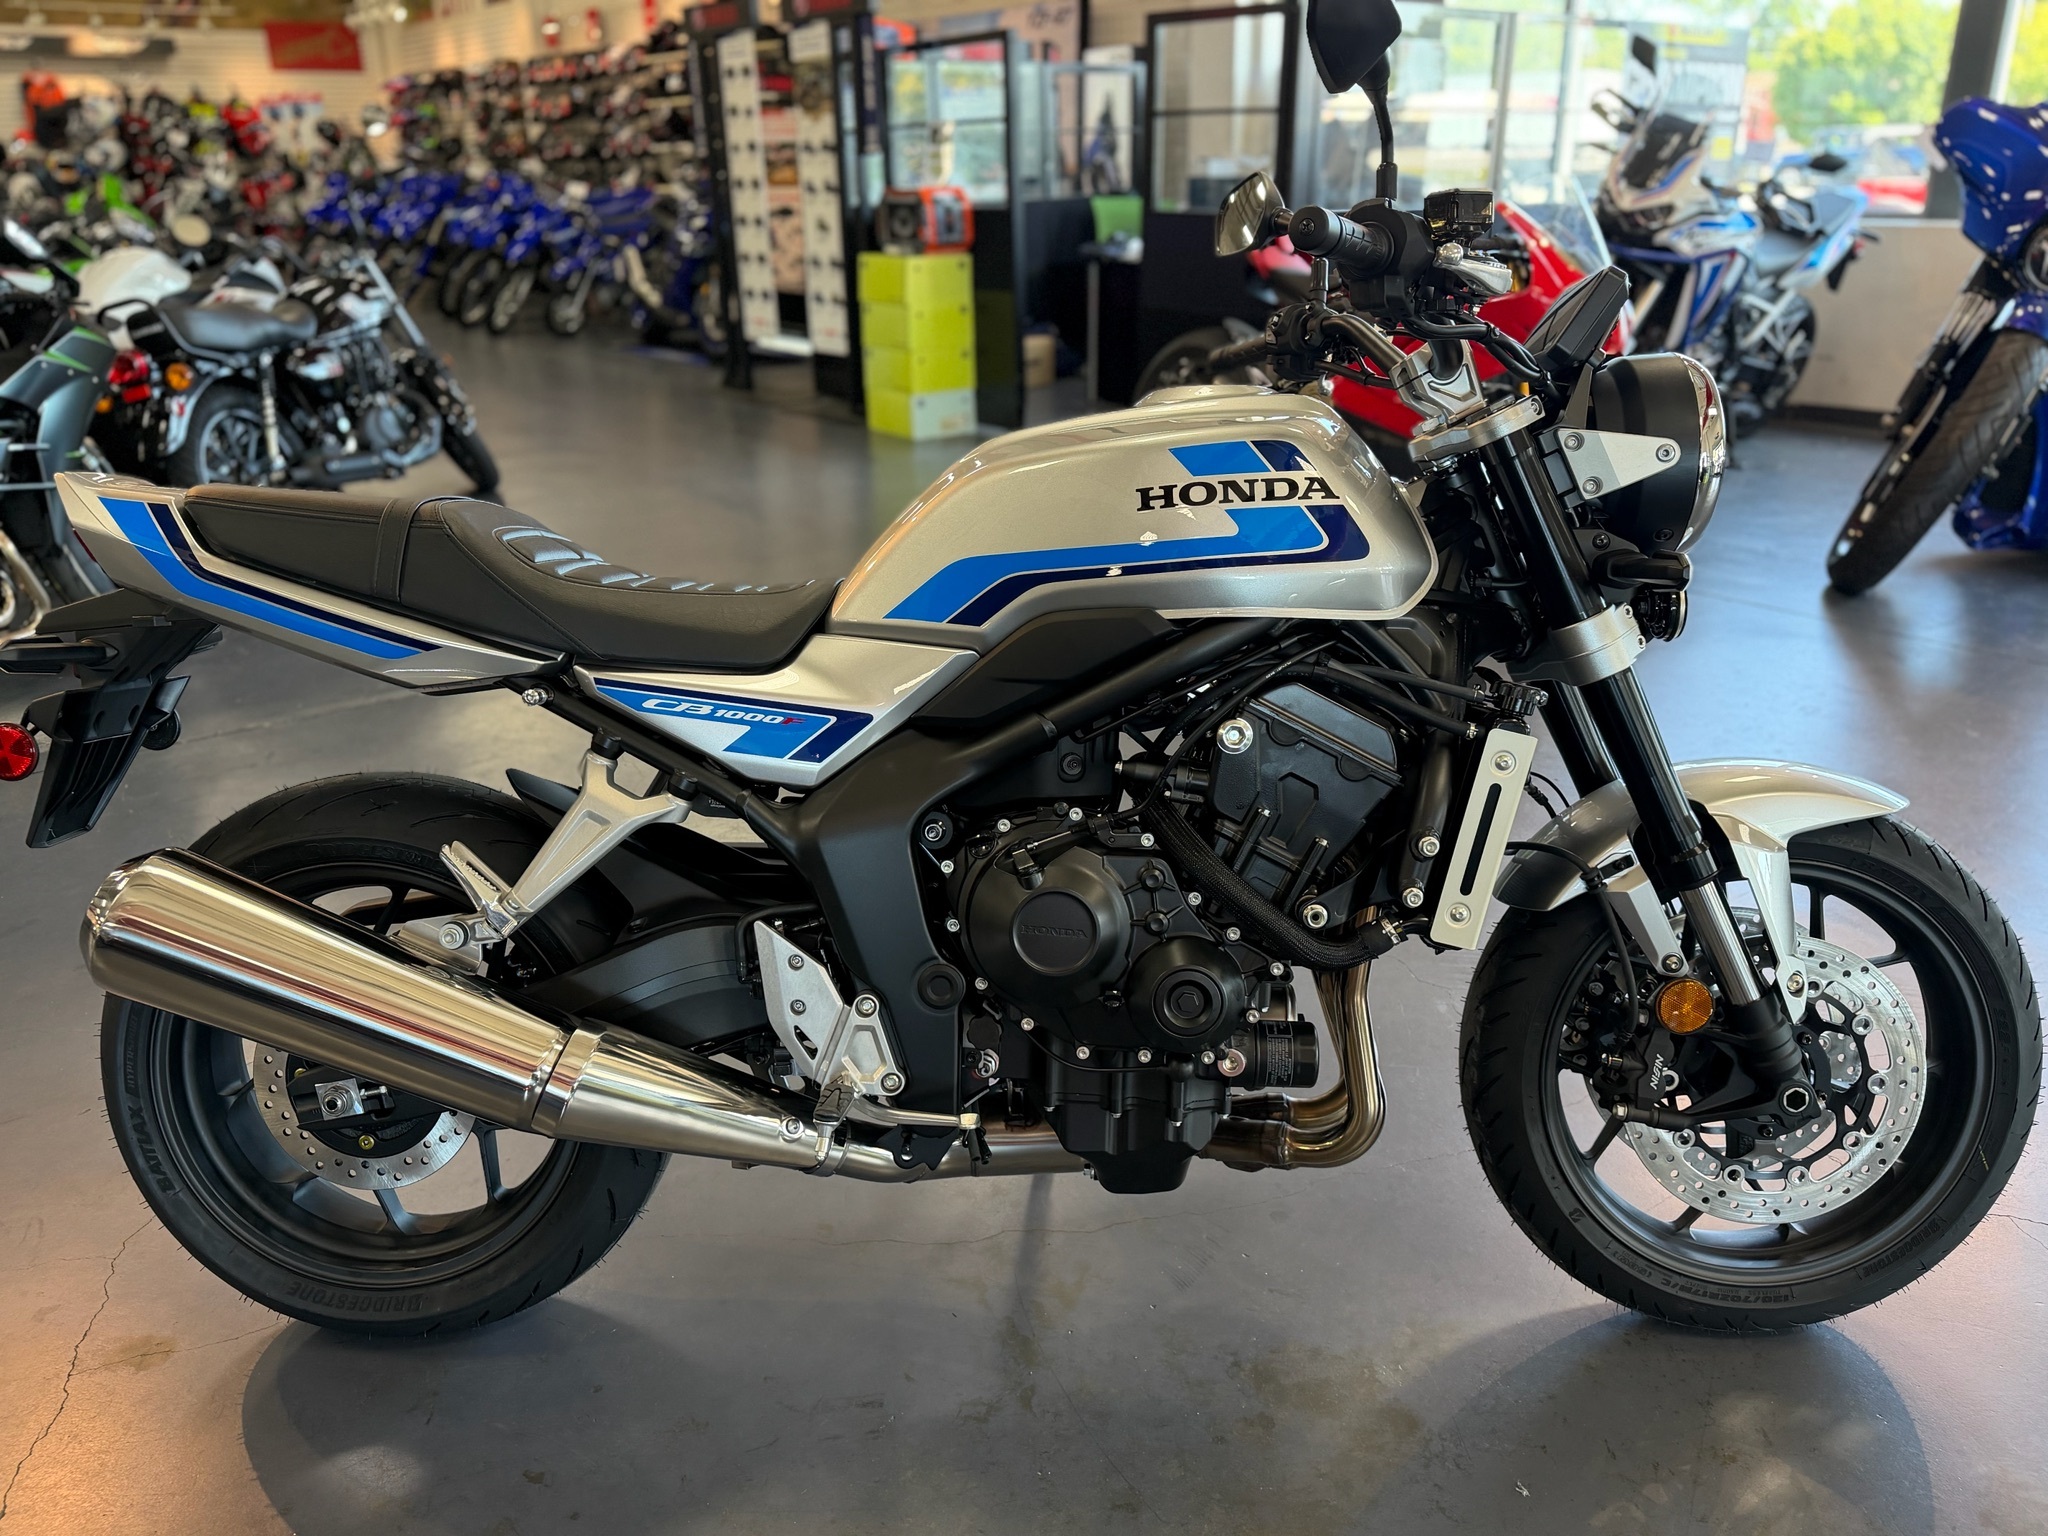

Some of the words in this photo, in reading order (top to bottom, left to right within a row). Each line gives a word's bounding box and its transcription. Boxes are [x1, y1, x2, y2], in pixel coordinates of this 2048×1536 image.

[1135, 476, 1341, 512] HONDA
[1020, 924, 1088, 939] HONDA
[287, 1281, 425, 1313] BRIDGESTONE
